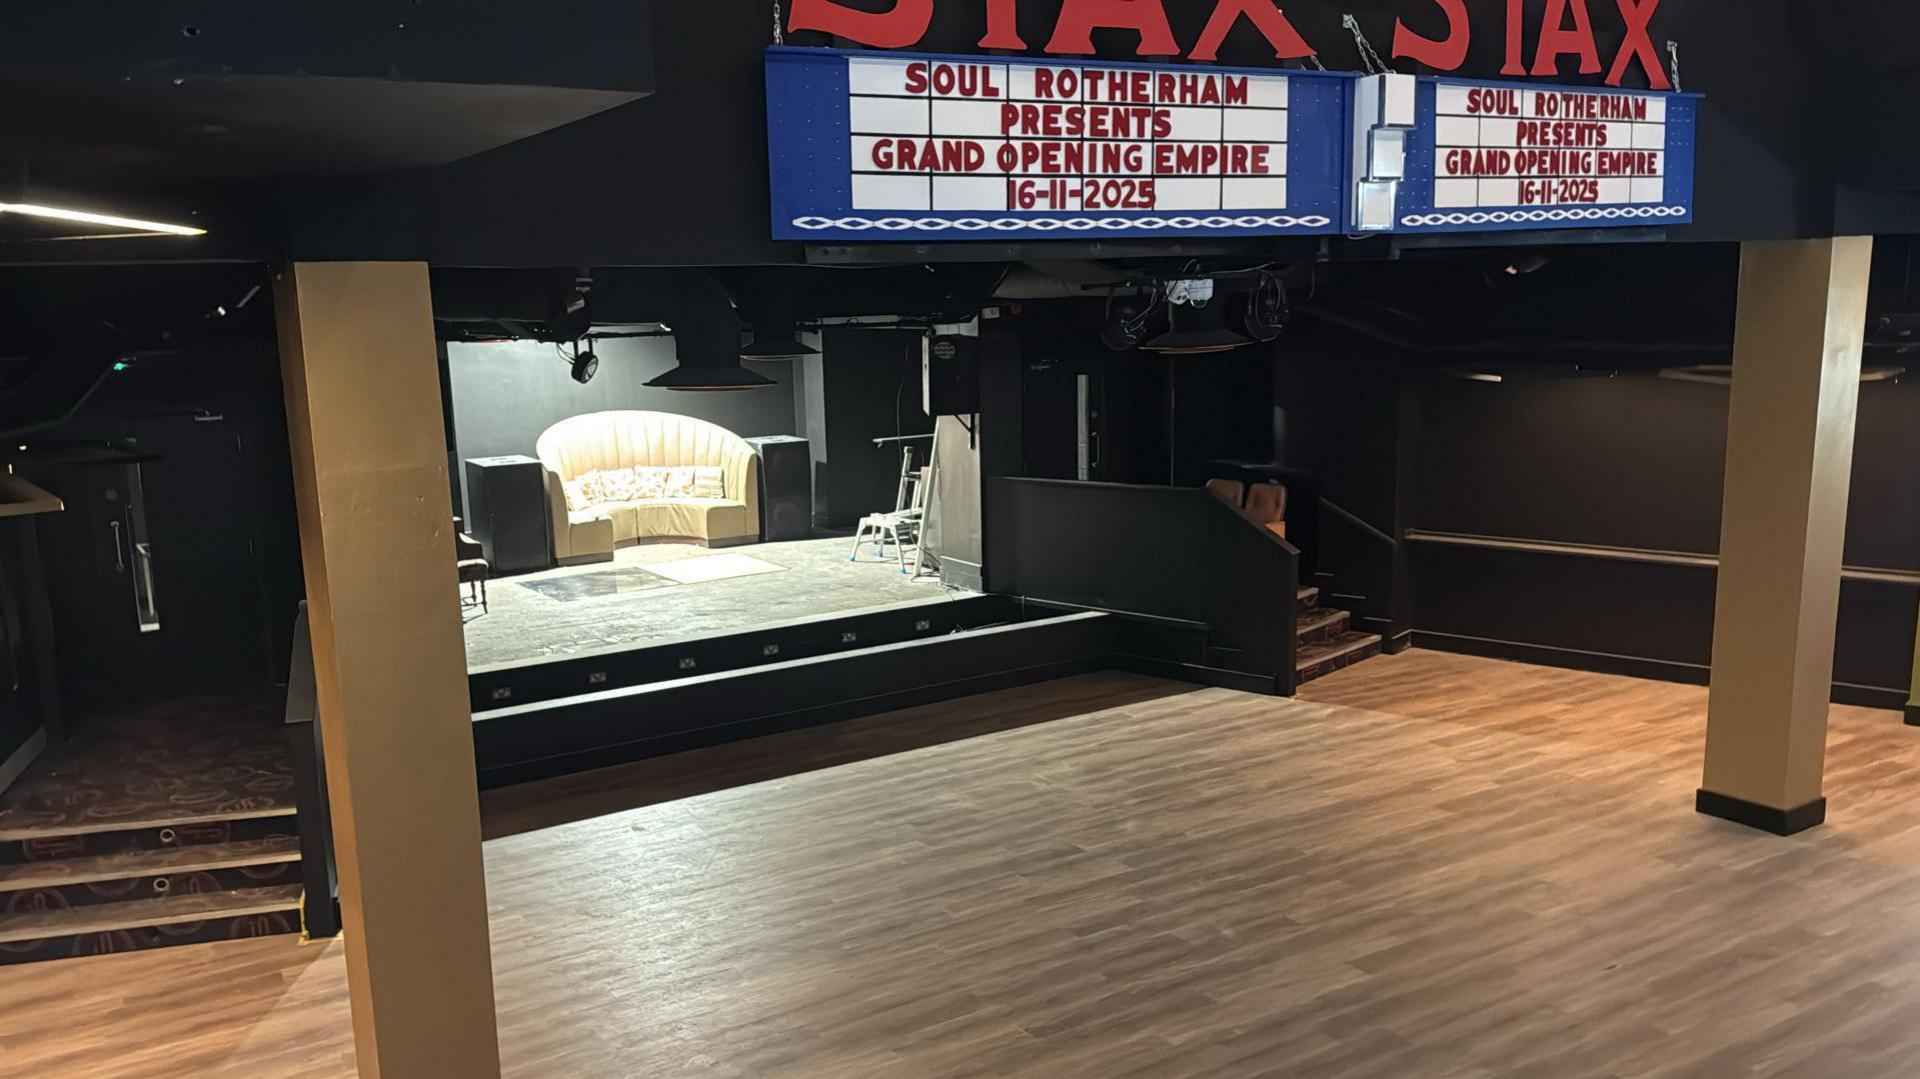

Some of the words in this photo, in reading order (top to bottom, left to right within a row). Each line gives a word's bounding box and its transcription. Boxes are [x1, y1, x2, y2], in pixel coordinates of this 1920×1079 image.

[905, 63, 1000, 97] SOUL
[1035, 68, 1248, 105] ROTHERHAM
[1466, 88, 1519, 115] SOUL
[1534, 92, 1647, 120] ROTHERHAM
[1000, 103, 1172, 138] PRESENTS
[1516, 121, 1608, 147] PRESENTS
[871, 138, 986, 172] GRAND
[999, 141, 1144, 174] OPENING
[1155, 144, 1270, 174] EMPIRE
[1445, 149, 1511, 175] GRAND
[1514, 150, 1592, 175] OPENING
[1597, 150, 1658, 175] EMPIRE
[1008, 179, 1156, 209] 16-11-2025
[1518, 179, 1599, 204] 16-11-2025
